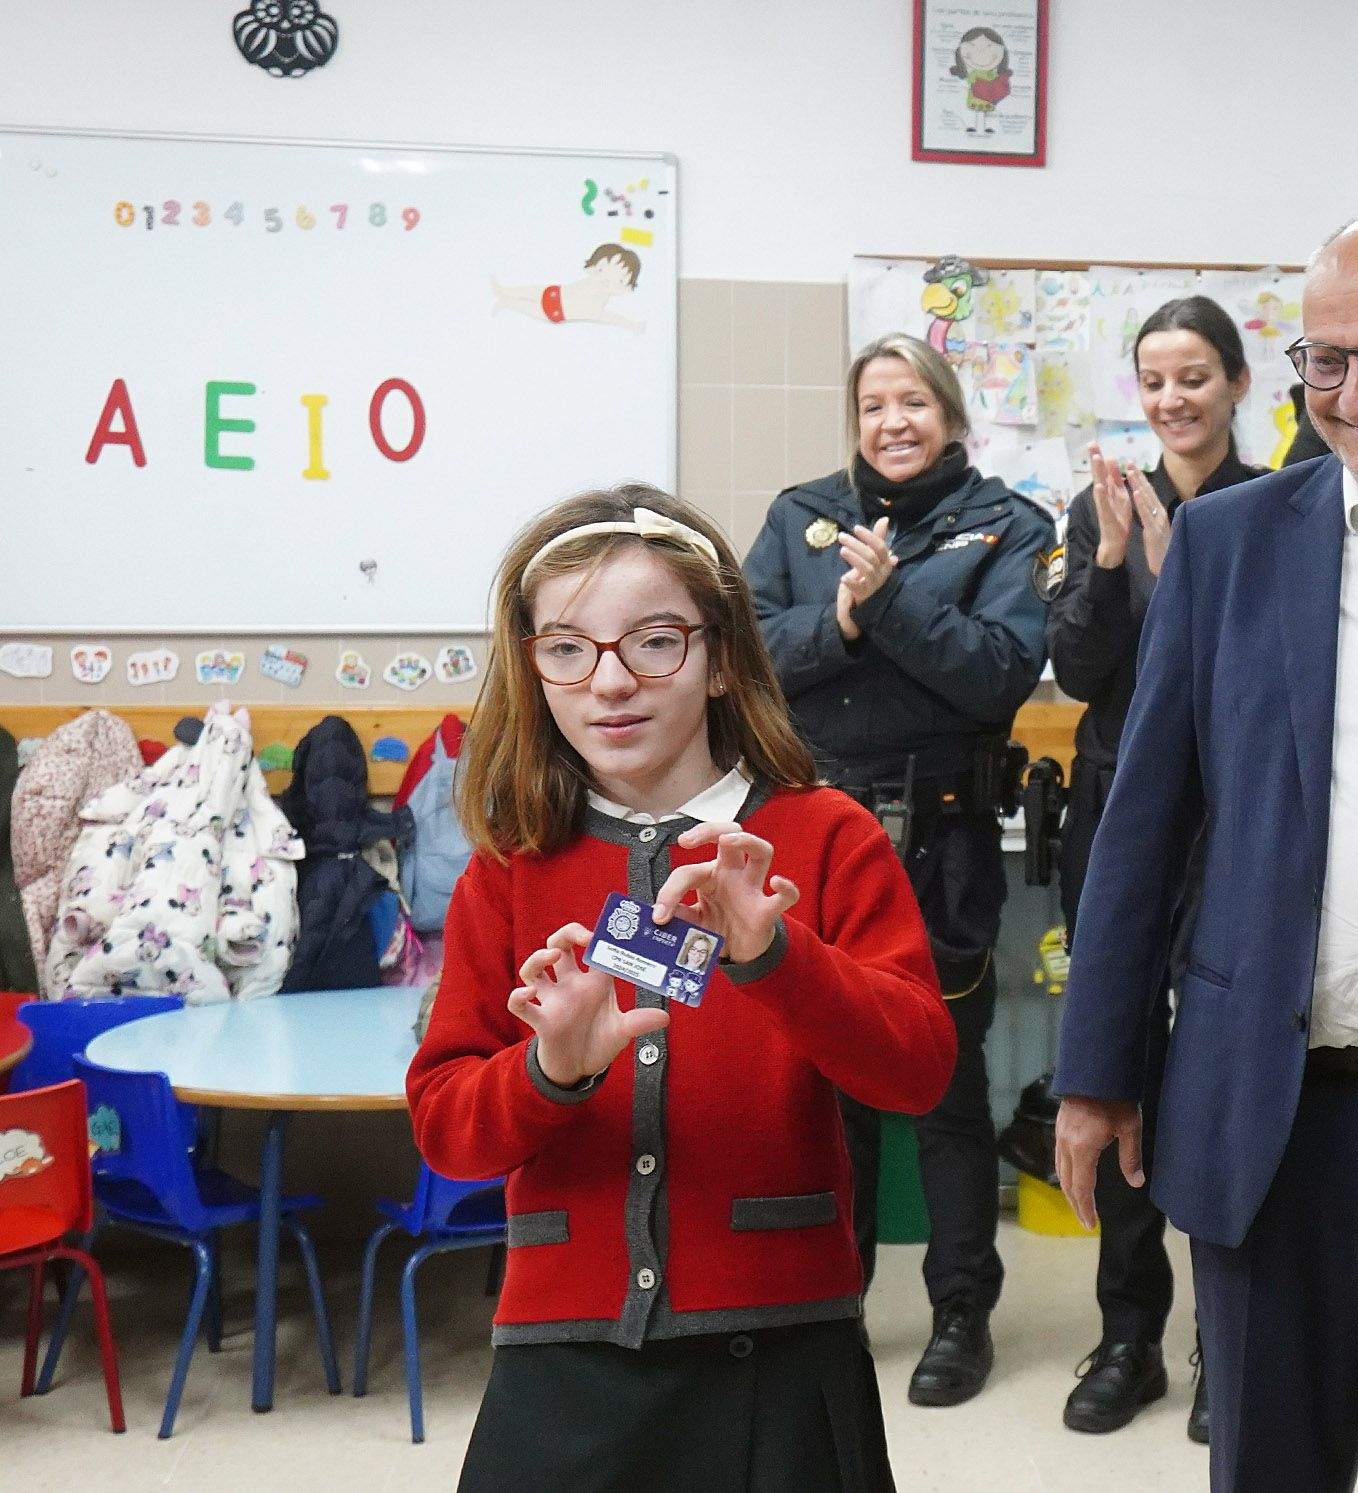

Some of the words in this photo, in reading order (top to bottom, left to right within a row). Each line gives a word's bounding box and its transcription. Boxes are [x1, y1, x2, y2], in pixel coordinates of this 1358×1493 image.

[114, 201, 134, 226] 0
[143, 206, 154, 230] 1
[161, 200, 181, 225] 2
[192, 202, 212, 226] 3
[224, 203, 244, 225] 4
[264, 208, 283, 231] 5
[295, 205, 316, 230] 6
[330, 204, 348, 230] 7
[369, 203, 387, 226] 8
[402, 208, 421, 231] 9
[85, 378, 147, 467] A
[204, 380, 256, 470] E
[300, 394, 331, 480] I
[369, 377, 425, 462] O
